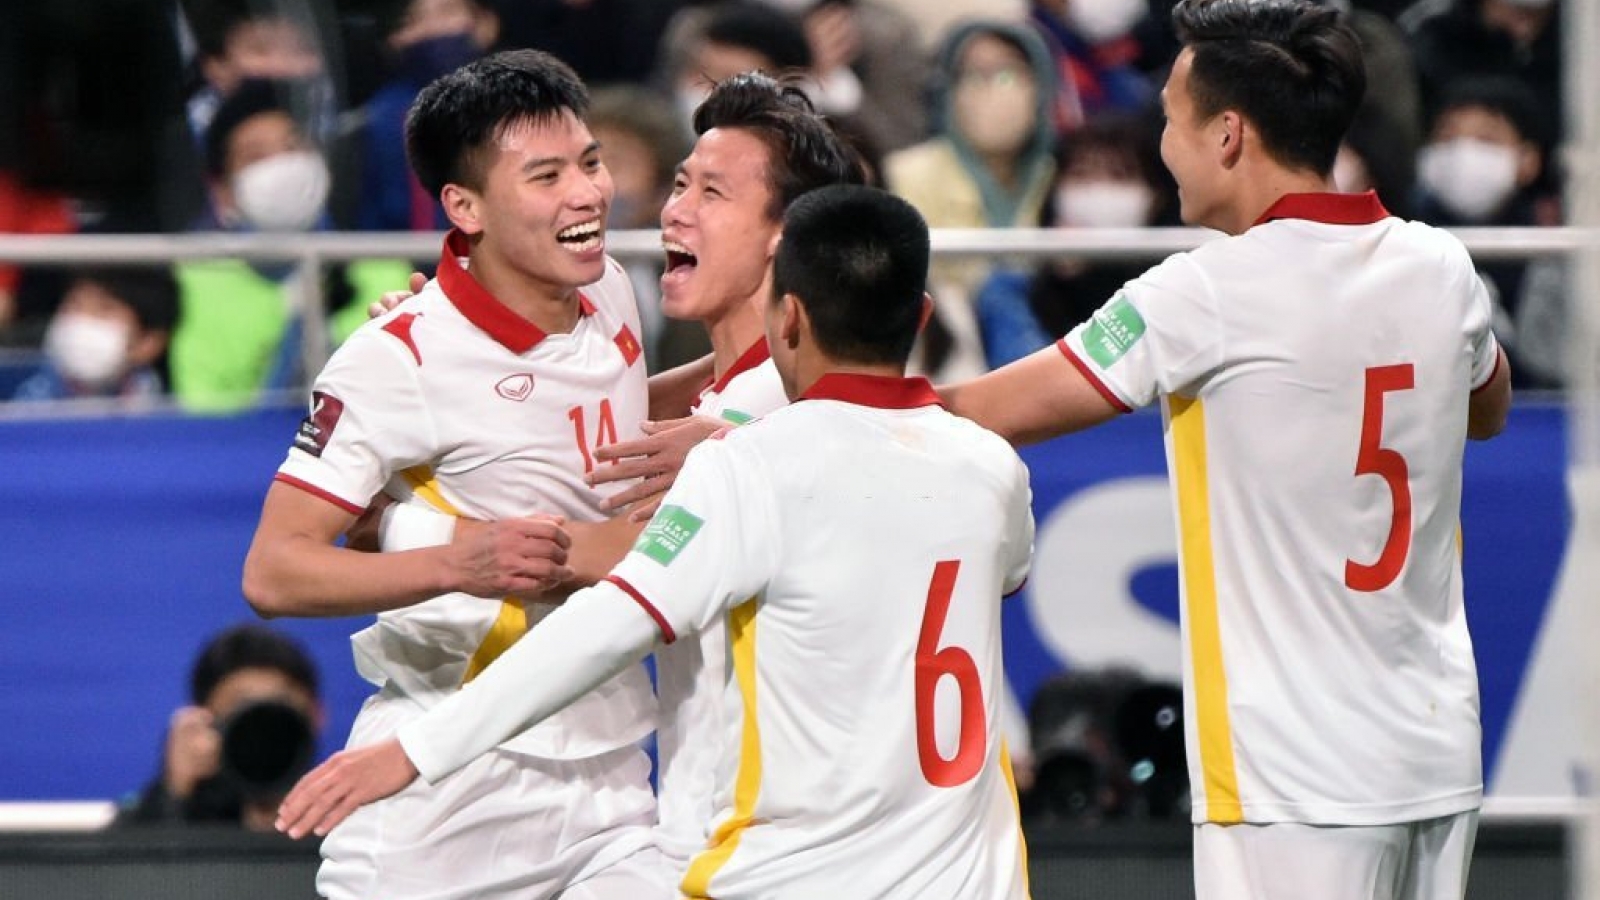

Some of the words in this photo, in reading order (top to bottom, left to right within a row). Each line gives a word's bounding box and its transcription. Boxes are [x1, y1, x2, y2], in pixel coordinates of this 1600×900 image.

[568, 398, 618, 488] 14
[1345, 364, 1415, 592] 5
[914, 560, 986, 788] 6
